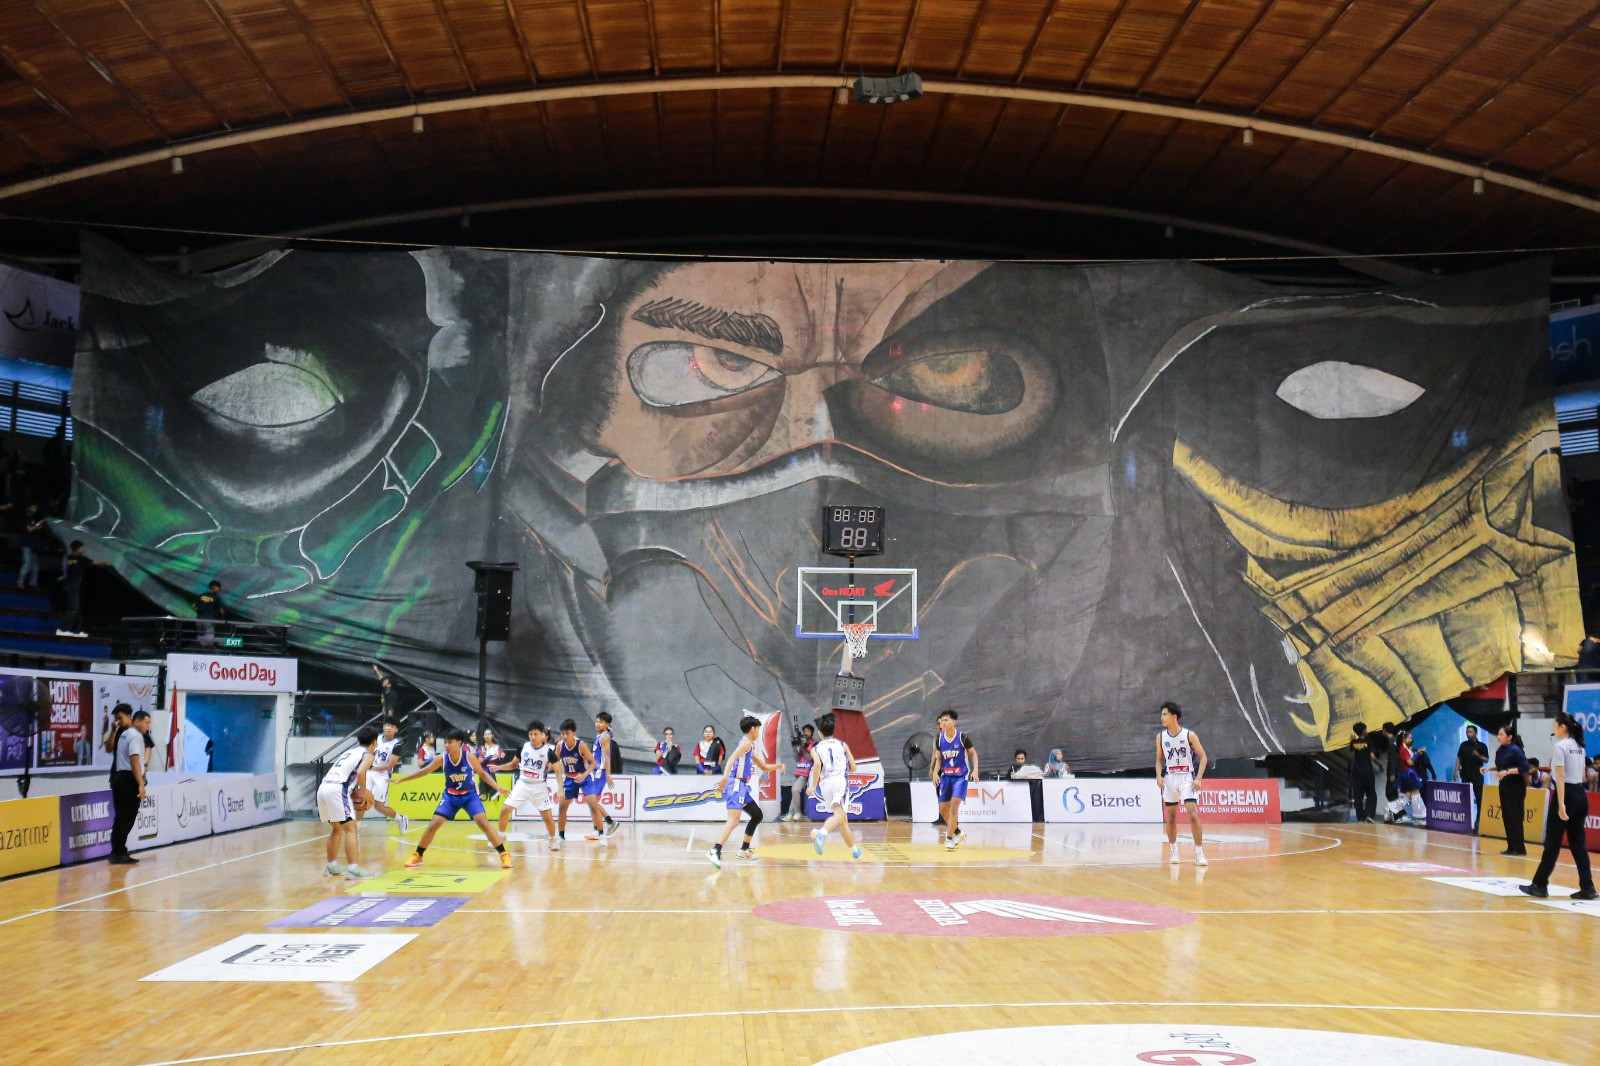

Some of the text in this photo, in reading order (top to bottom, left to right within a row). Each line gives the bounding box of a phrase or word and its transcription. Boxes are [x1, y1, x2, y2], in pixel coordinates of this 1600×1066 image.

[821, 587, 839, 597] One
[225, 638, 242, 646] EXIT
[50, 704, 79, 723] CREAM
[948, 758, 955, 767] 4
[227, 797, 244, 813] Biznet
[1090, 793, 1142, 807] Biznet
[1217, 790, 1268, 806] CREAM
